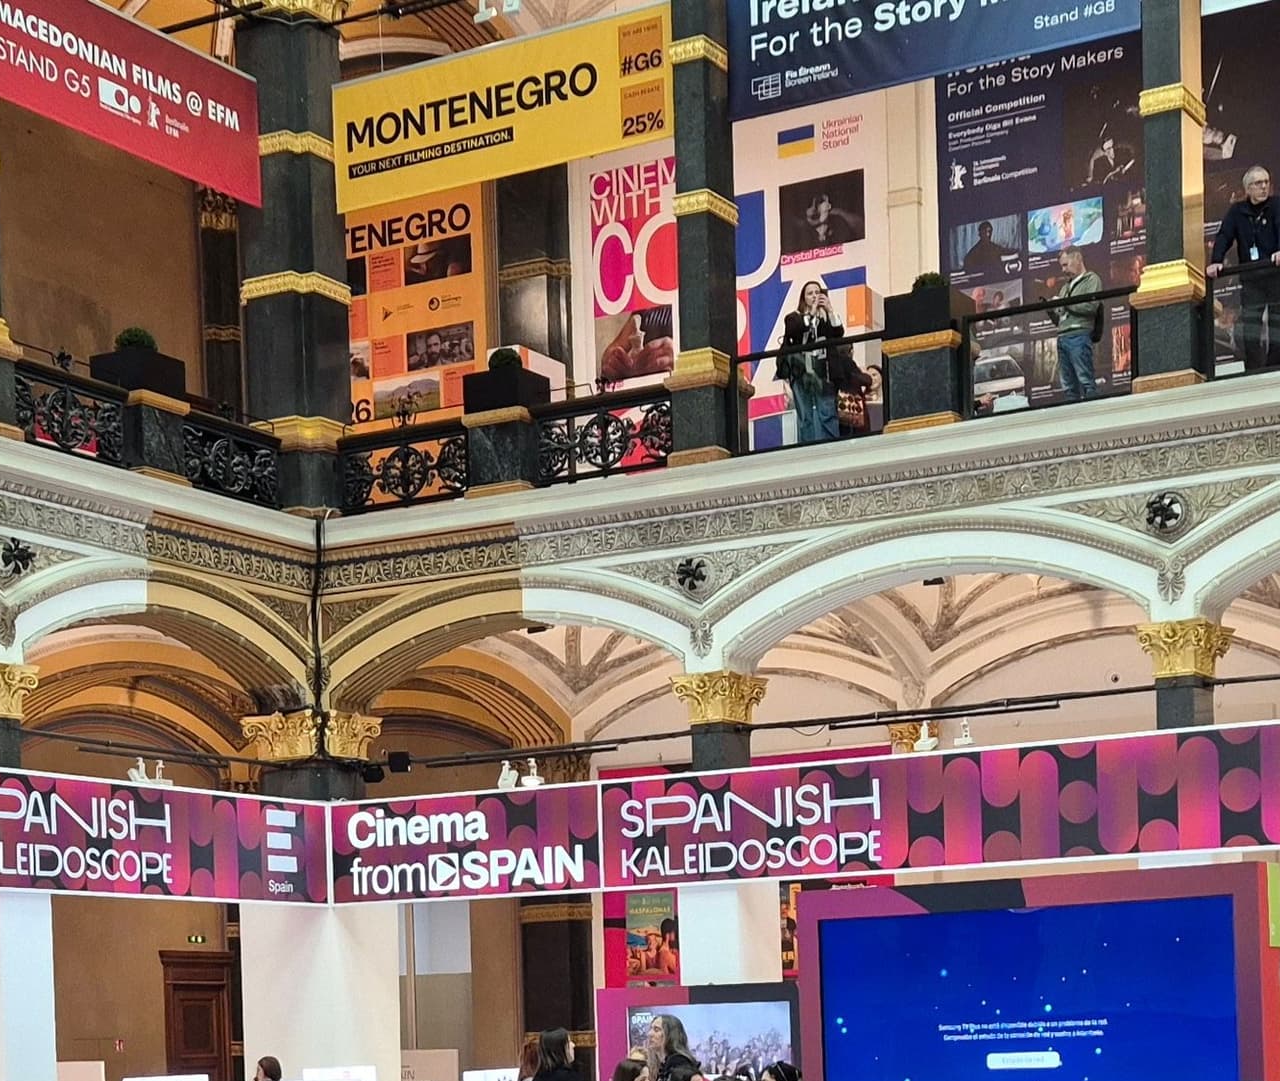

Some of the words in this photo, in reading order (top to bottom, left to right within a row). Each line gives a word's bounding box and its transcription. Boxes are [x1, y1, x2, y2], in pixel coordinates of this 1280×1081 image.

[751, 30, 799, 61] For
[810, 16, 862, 47] the
[874, 0, 966, 32] Story
[1033, 7, 1079, 30] Stand
[621, 49, 662, 76] #G6
[813, 67, 838, 81] Ireland
[947, 81, 973, 98] For
[979, 74, 1006, 89] the
[1011, 62, 1055, 83] Story
[1061, 46, 1124, 72] Makers
[64, 68, 91, 98] G5
[132, 64, 181, 104] FILMS
[186, 91, 203, 117] @
[207, 99, 240, 132] EFM
[346, 62, 598, 153] MONTENEGRO
[623, 109, 664, 136] 25%
[822, 114, 863, 130] Ukrainian
[948, 105, 983, 122] Official
[985, 94, 1046, 115] Competition
[822, 125, 859, 141] National
[822, 137, 849, 150] Stand
[351, 162, 377, 177] YOUR
[378, 156, 402, 171] NEXT
[404, 147, 442, 166] FILMING
[444, 131, 511, 155] DESTINATION.
[590, 188, 661, 225] WITH
[346, 203, 471, 253] ENEGRO
[781, 249, 813, 265] Crystal
[814, 245, 844, 259] Palace
[352, 399, 370, 423] 6
[620, 778, 881, 838] SPANISH
[347, 809, 488, 849] Cinema
[621, 830, 882, 878] KALEIDOSCOPE
[350, 857, 426, 896] from
[462, 844, 584, 889] SPAIN
[269, 879, 293, 893] Spain
